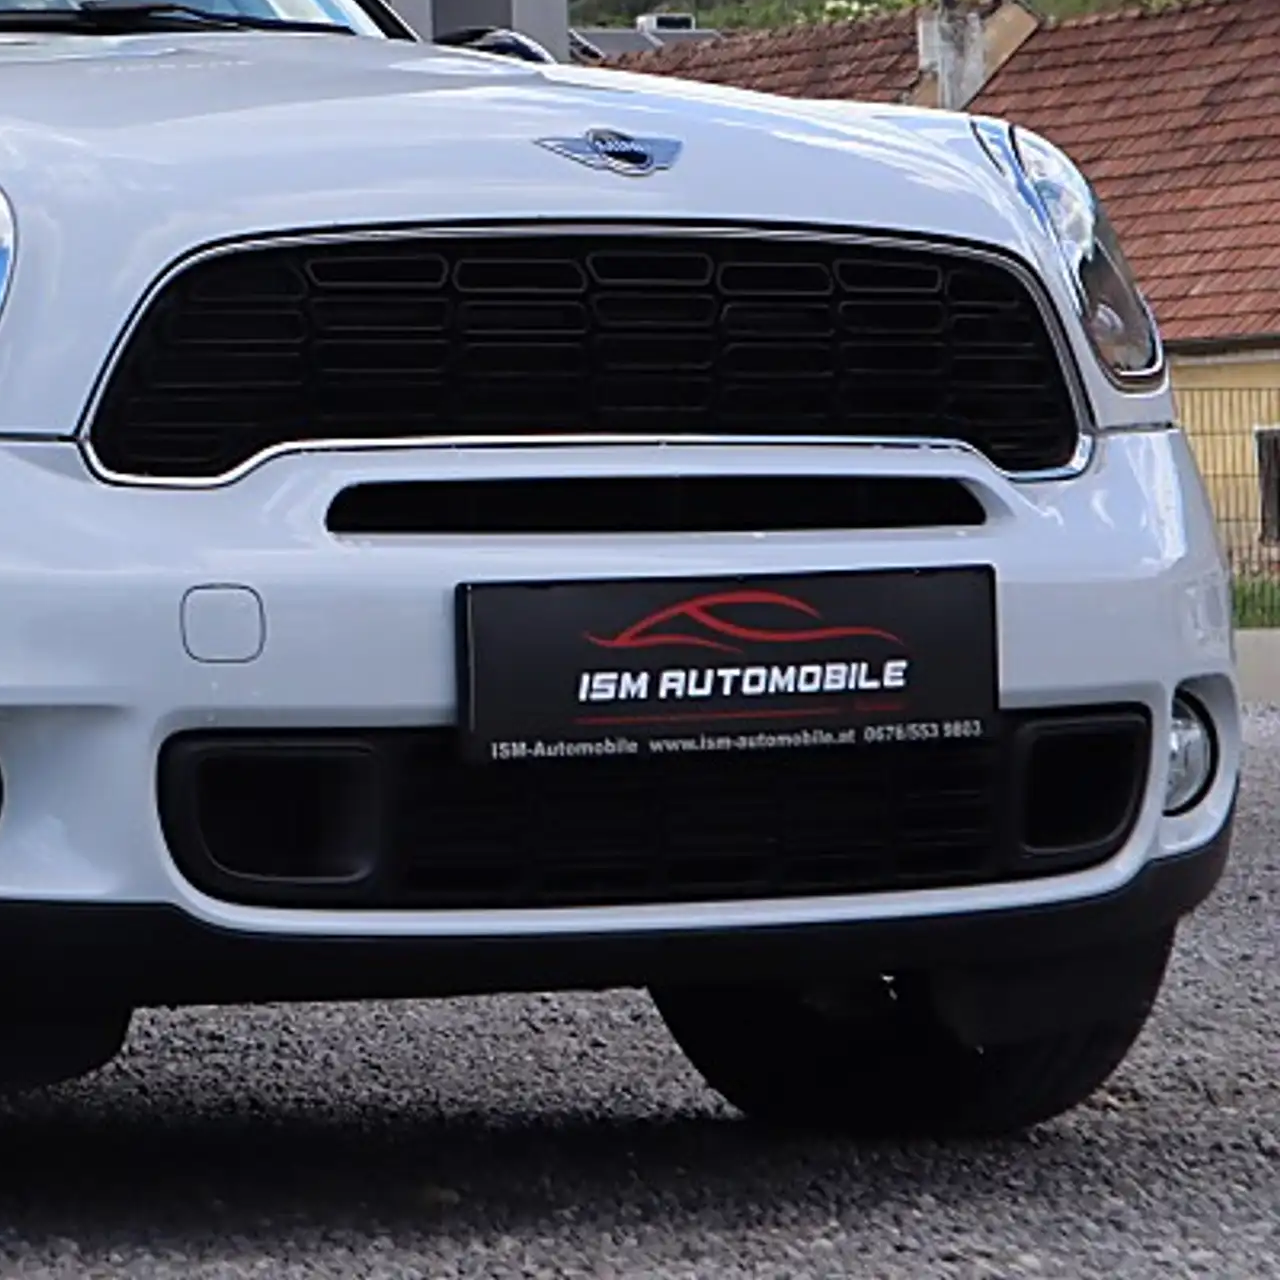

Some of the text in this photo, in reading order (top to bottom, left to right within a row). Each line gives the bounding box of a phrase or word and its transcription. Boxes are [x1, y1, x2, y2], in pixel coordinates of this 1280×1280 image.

[578, 659, 909, 702] ISM AUTOMOBILE
[491, 736, 638, 760] ISM-Automobile
[648, 728, 856, 753] www.ism-automobile.at
